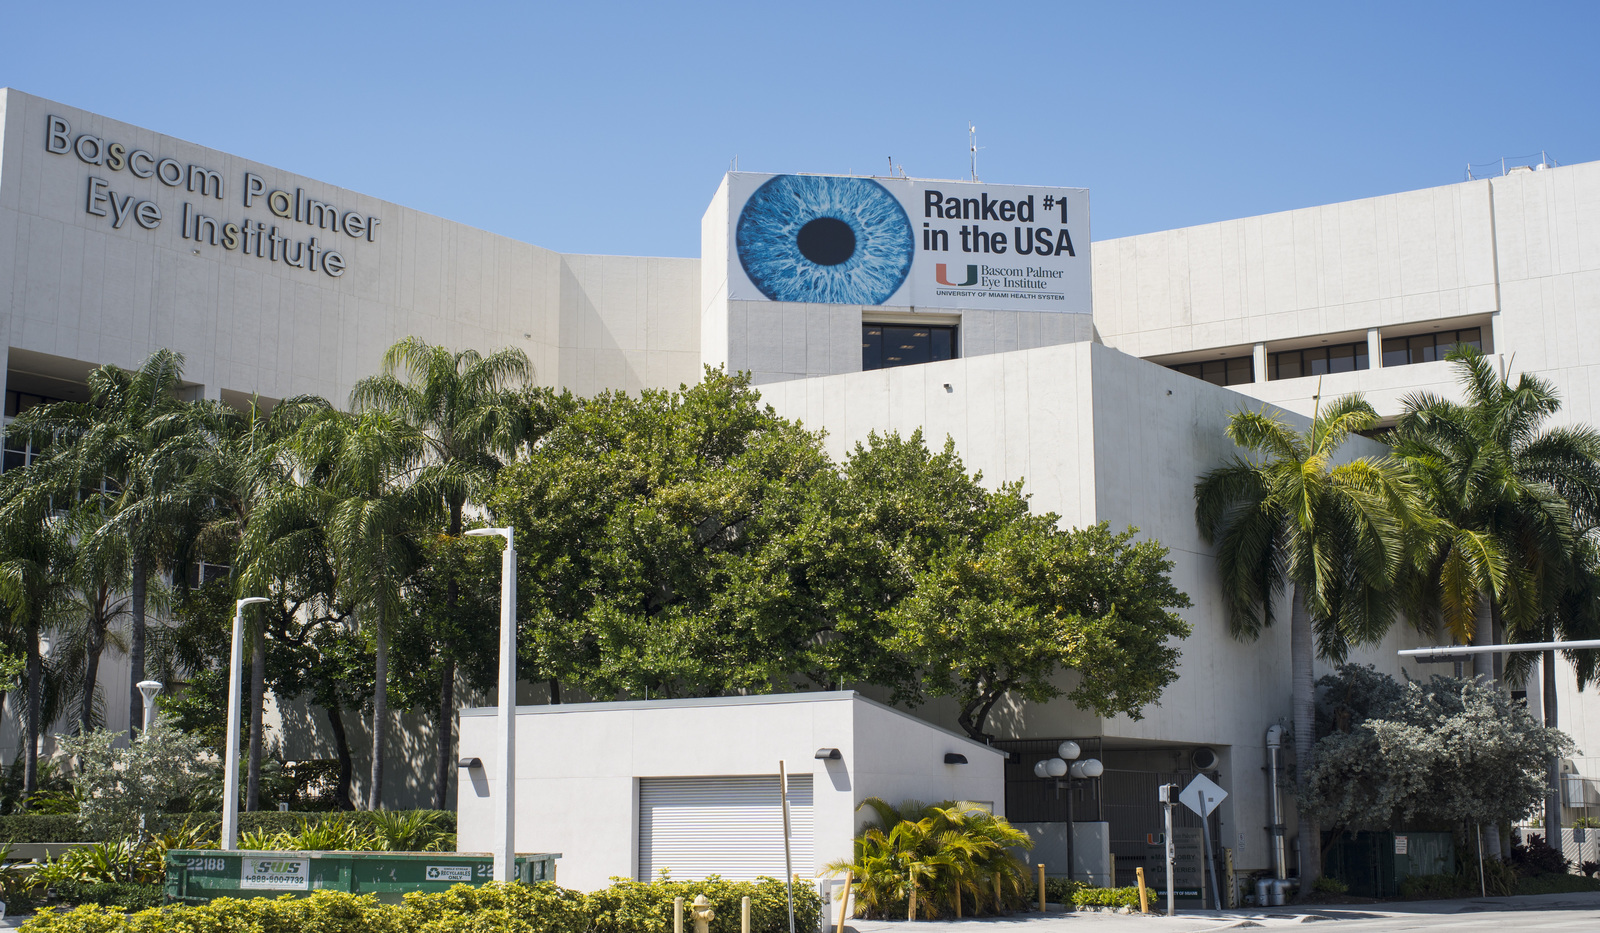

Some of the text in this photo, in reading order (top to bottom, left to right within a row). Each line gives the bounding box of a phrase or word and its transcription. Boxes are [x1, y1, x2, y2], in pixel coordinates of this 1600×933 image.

[46, 114, 381, 242] Bascom Palmer
[924, 189, 1068, 224] Ranked #1
[86, 176, 346, 278] Eye Institute
[923, 222, 1076, 257] in the USA
[981, 264, 1064, 279] Bascom Palmer
[981, 276, 1047, 289] Eye Institute
[187, 858, 225, 870] 22188
[258, 862, 301, 873] SWS
[478, 864, 519, 876] 228
